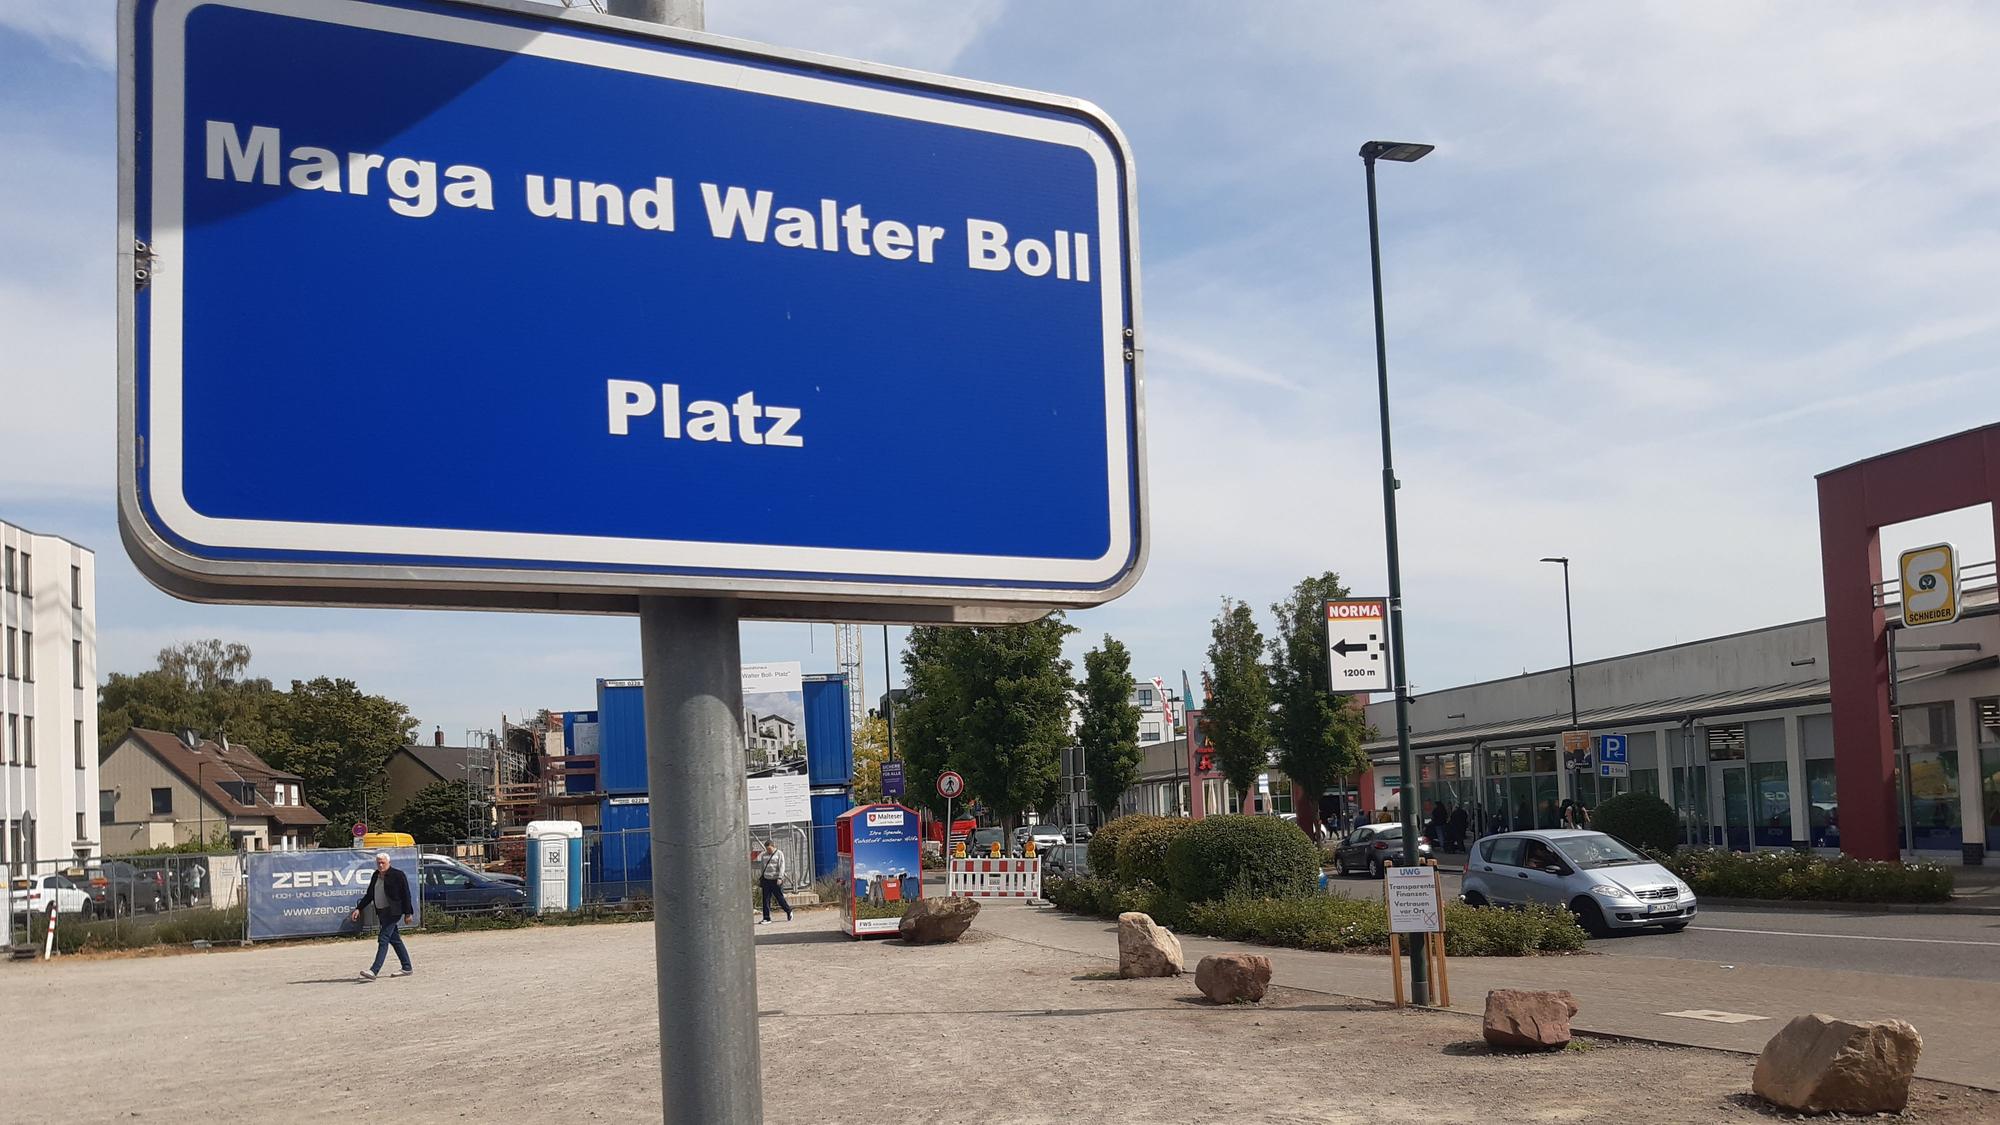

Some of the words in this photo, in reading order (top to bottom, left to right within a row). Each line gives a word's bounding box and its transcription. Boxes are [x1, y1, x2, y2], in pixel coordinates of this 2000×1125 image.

[205, 119, 495, 218] Marga
[526, 175, 676, 233] und
[700, 182, 946, 264] Walter
[966, 218, 1092, 282] Boll
[606, 378, 804, 448] Platz
[1328, 604, 1381, 618] NORMA
[1909, 608, 1951, 622] SCHNEIDER
[1343, 668, 1366, 677] 1200
[1366, 669, 1376, 677] m
[1606, 738, 1620, 758] P
[877, 812, 903, 820] Malteser
[272, 869, 374, 889] ZERVO
[1399, 868, 1421, 876] UWG
[283, 905, 357, 917] www.zervos-
